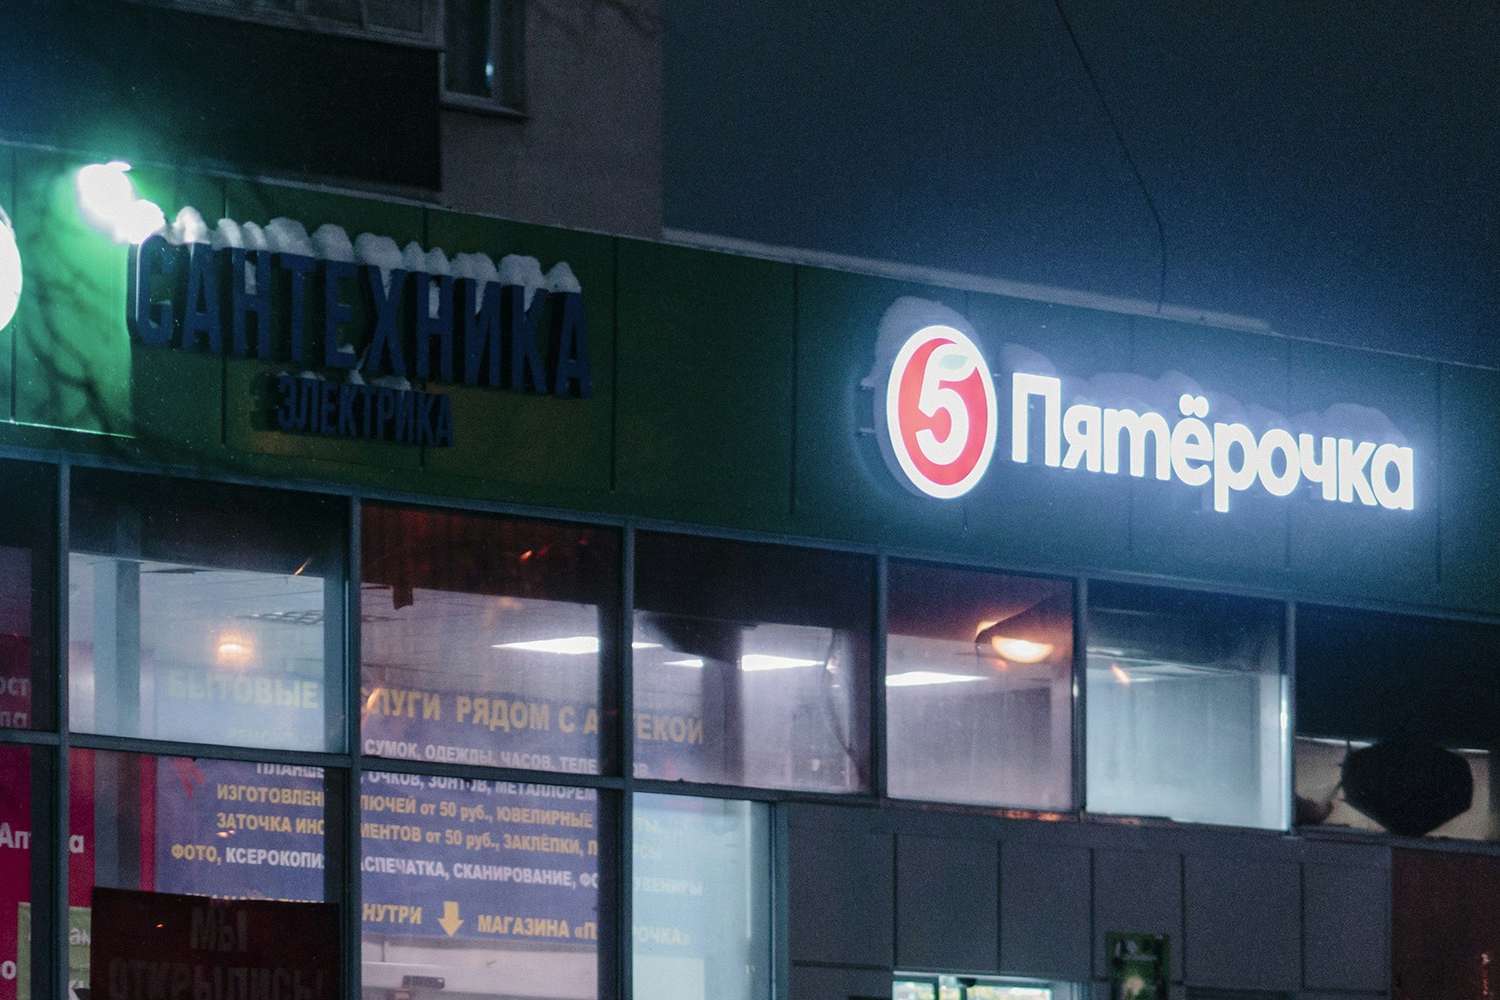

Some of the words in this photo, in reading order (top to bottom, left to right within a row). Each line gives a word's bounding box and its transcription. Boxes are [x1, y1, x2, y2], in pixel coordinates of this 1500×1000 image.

[134, 234, 594, 400] САНТЕХНИКА
[275, 374, 454, 449] ЭЛЕКТРИКА
[914, 342, 980, 466] 5
[1012, 371, 1415, 513] Пятёрочка
[456, 696, 550, 732] РЯДОМ
[558, 707, 576, 733] С
[216, 812, 291, 833] ЗАТОЧКА
[426, 830, 441, 844] от
[446, 829, 463, 845] 50
[420, 802, 435, 815] от
[440, 801, 457, 817] 50
[497, 806, 594, 828] ЮВЕЛИРНЫЕ
[171, 843, 222, 865] ФОТО,
[226, 847, 324, 869] КСЕРОКОПИ
[453, 863, 577, 888] СКАНИРОВАНИЕ,
[478, 914, 570, 939] МАГАЗИНА
